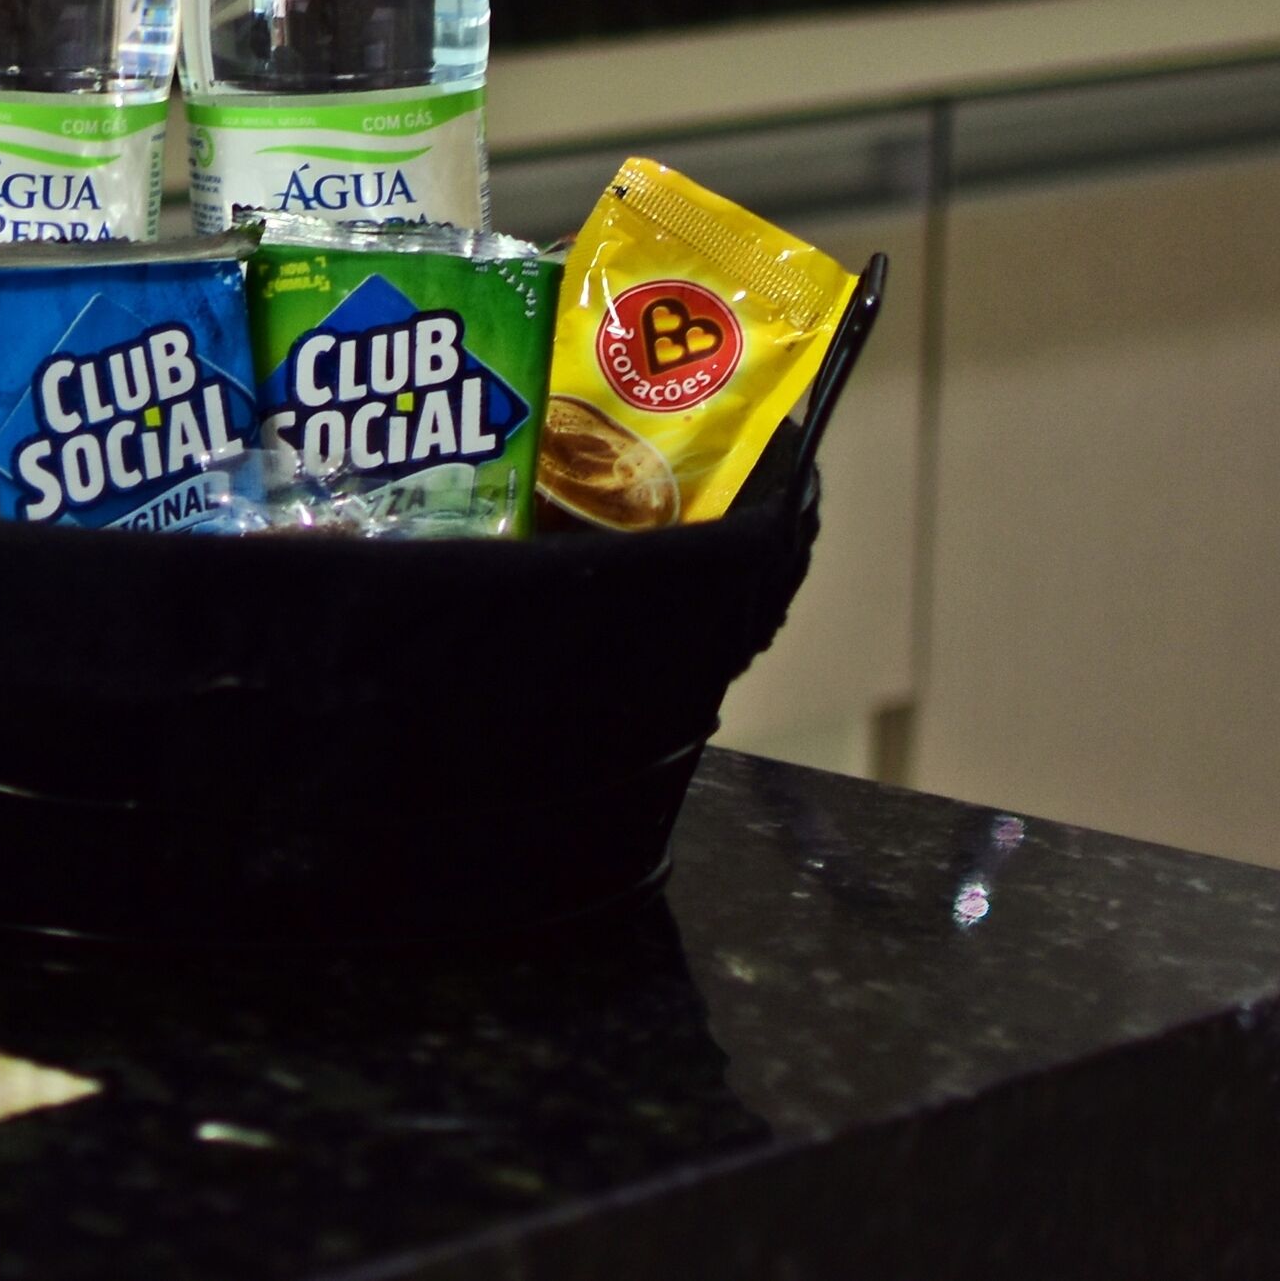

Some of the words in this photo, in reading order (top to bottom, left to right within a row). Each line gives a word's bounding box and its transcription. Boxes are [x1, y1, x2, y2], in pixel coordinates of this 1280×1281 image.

[61, 119, 99, 135] COM
[362, 116, 401, 132] COM
[404, 110, 433, 127] GÁS
[272, 162, 418, 211] ÁGUA
[42, 329, 197, 434] CLUB
[296, 317, 460, 407] CLUB
[608, 342, 712, 406] corações
